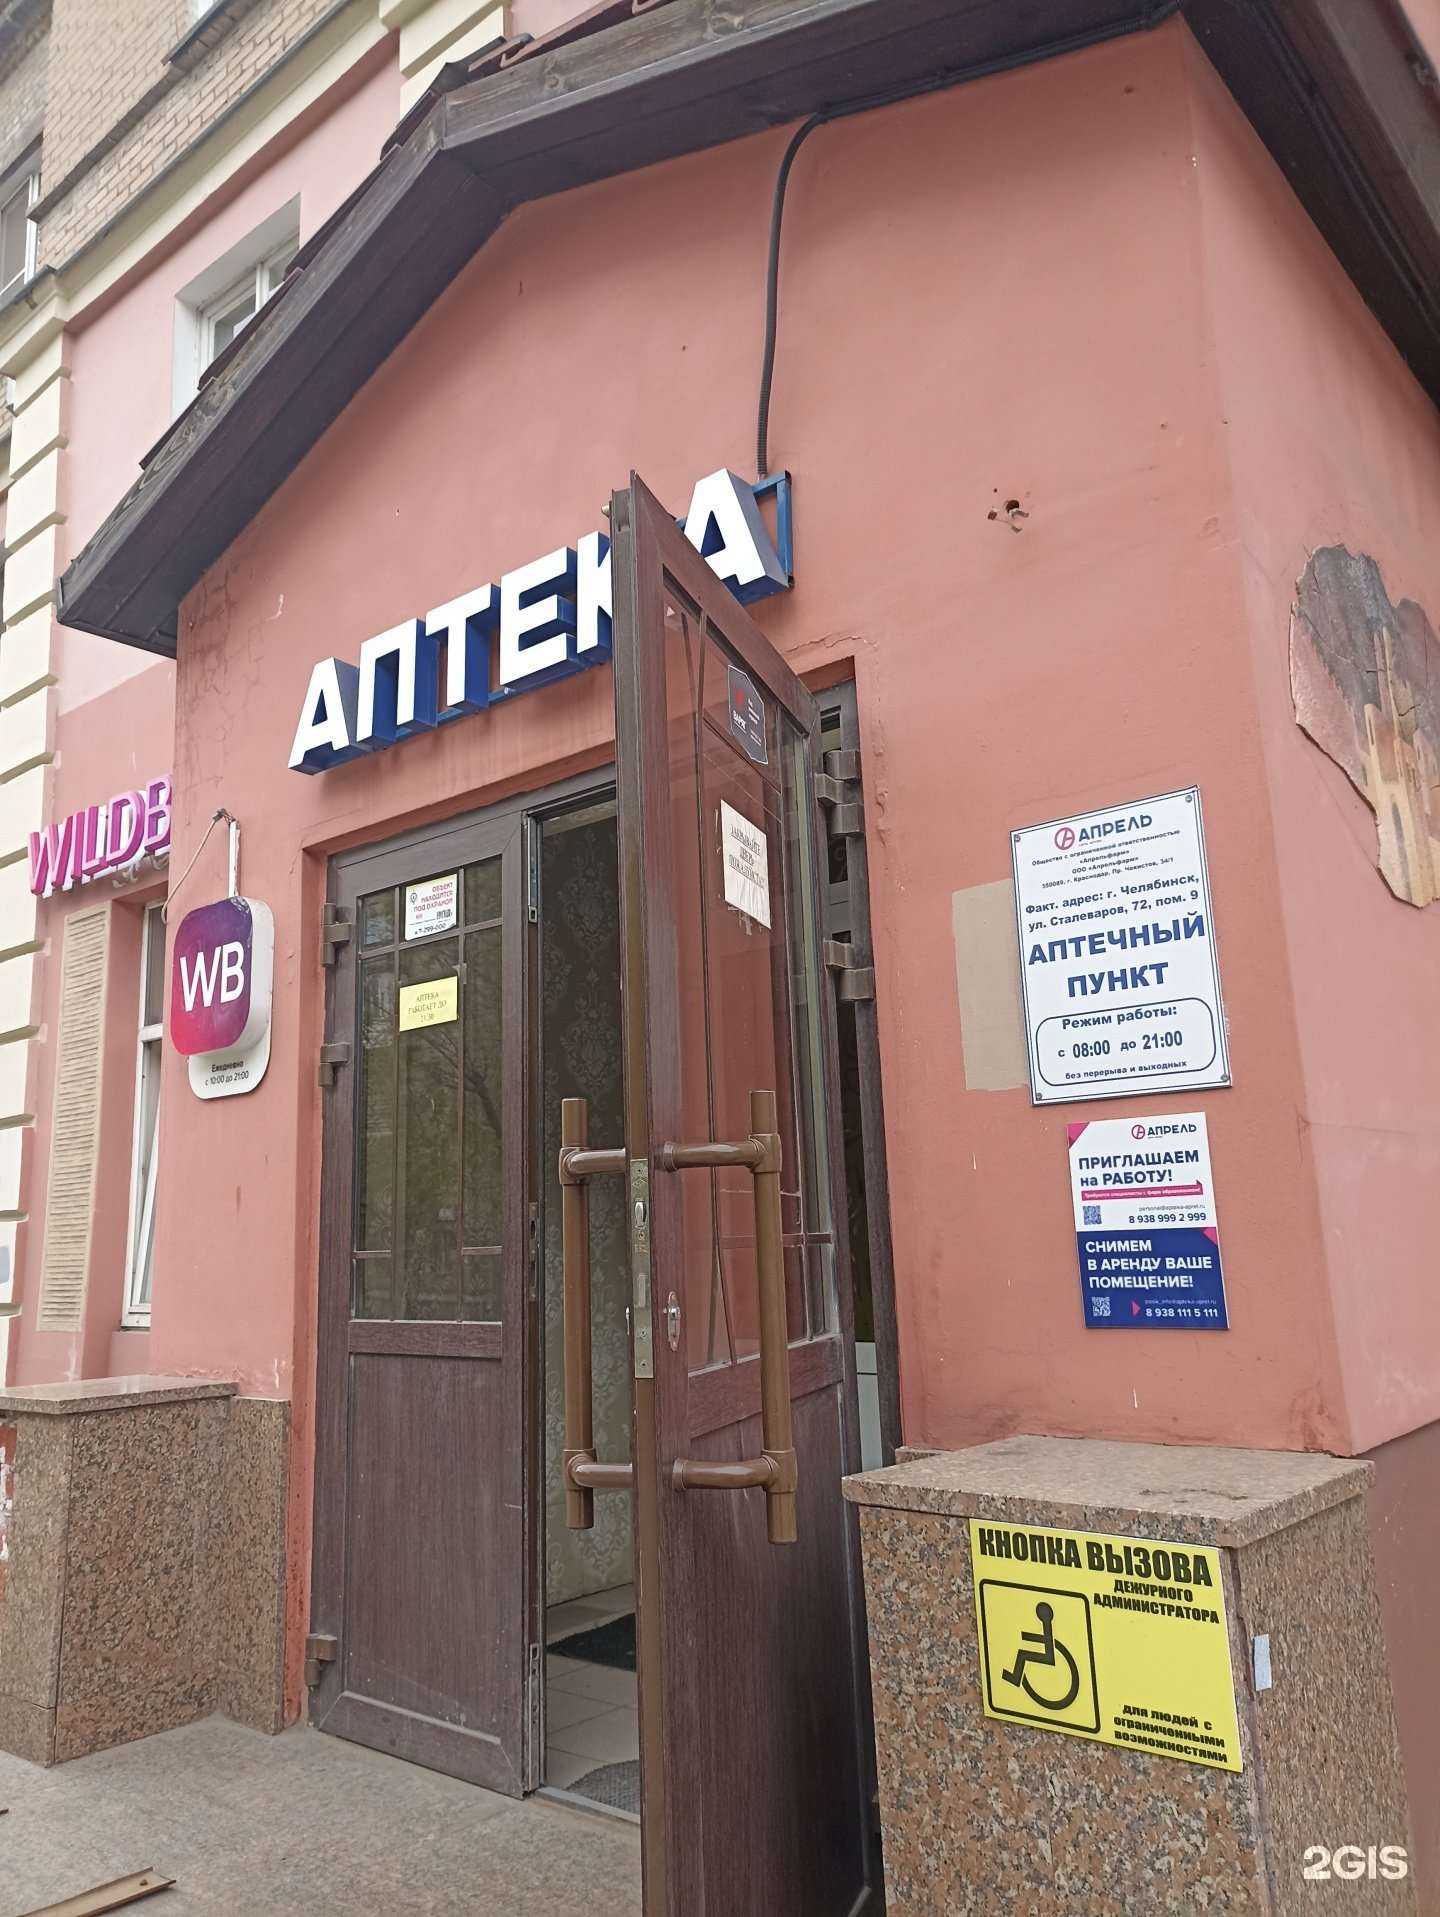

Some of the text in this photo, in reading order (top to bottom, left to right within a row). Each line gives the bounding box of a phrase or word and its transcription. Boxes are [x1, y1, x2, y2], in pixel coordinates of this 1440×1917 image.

[1078, 814, 1153, 842] АПРЕЛЬ
[1072, 866, 1087, 874] ООО
[1025, 874, 1199, 914] Факт. адрес: г. Челябинск,
[1028, 889, 1199, 933] ул. Сталеваров, 72, пом. 9
[1028, 911, 1205, 965] АПТЕЧНЫЙ
[180, 940, 245, 1012] WB
[1067, 962, 1169, 998] ПУНКТ
[1062, 1006, 1178, 1030] Режим работы:
[1058, 1030, 1183, 1058] с 08:00 до 21:00
[1065, 1072, 1081, 1080] без
[1083, 1066, 1127, 1078] перерыва
[1138, 1060, 1187, 1072] выходных
[1147, 1124, 1197, 1136] АПРЕЛЬ
[1078, 1149, 1200, 1170] ПРИГЛАШАЕМ
[1080, 1169, 1173, 1187] на РАБОТУ!
[1129, 1212, 1206, 1223] 8 938 999 2 999
[1085, 1239, 1152, 1253] СНИМЕМ
[1087, 1256, 1212, 1272] В АРЕНДУ ВАШЕ
[1089, 1275, 1194, 1290] ПОМЕЩЕНИЕ!
[1145, 1308, 1218, 1318] 8 938 111 5 111
[978, 1528, 1213, 1587] КНОПКА ВЫЗОВА
[1113, 1579, 1194, 1603] ДЕЖУРНОГО
[1093, 1593, 1220, 1624] АДМИНИСТРАТОРА
[1204, 1721, 1212, 1731] с
